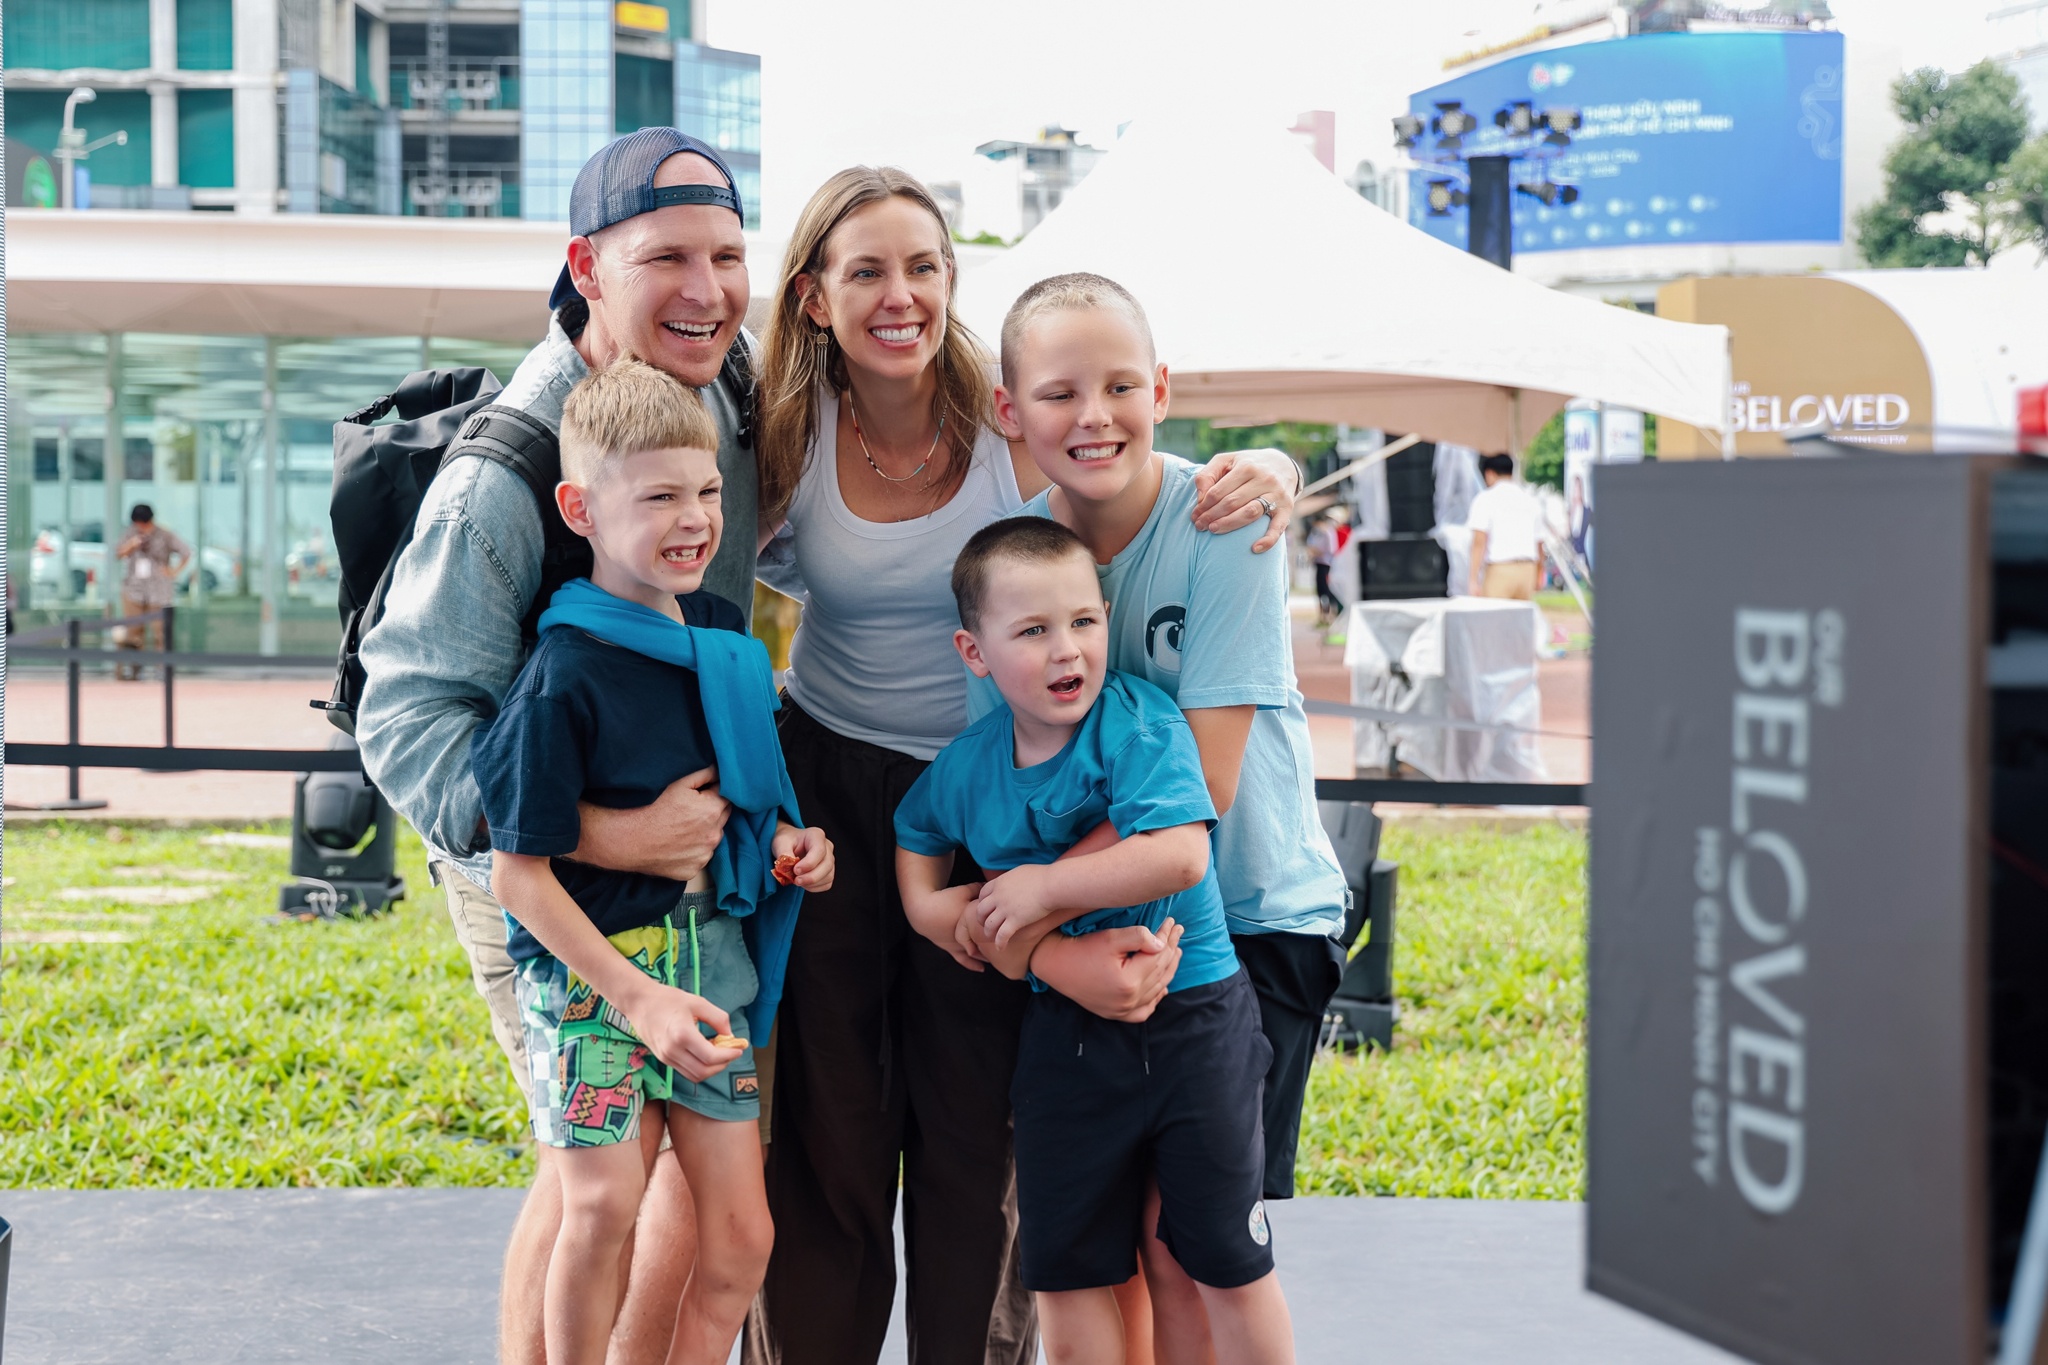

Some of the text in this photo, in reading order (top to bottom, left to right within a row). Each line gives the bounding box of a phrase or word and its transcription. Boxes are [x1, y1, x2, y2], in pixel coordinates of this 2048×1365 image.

[1728, 394, 1910, 433] BELOVED
[1813, 607, 1844, 706] OUR
[1691, 826, 1722, 1187] HO CHI MINH CITY
[1727, 608, 1809, 1215] BELOVED
